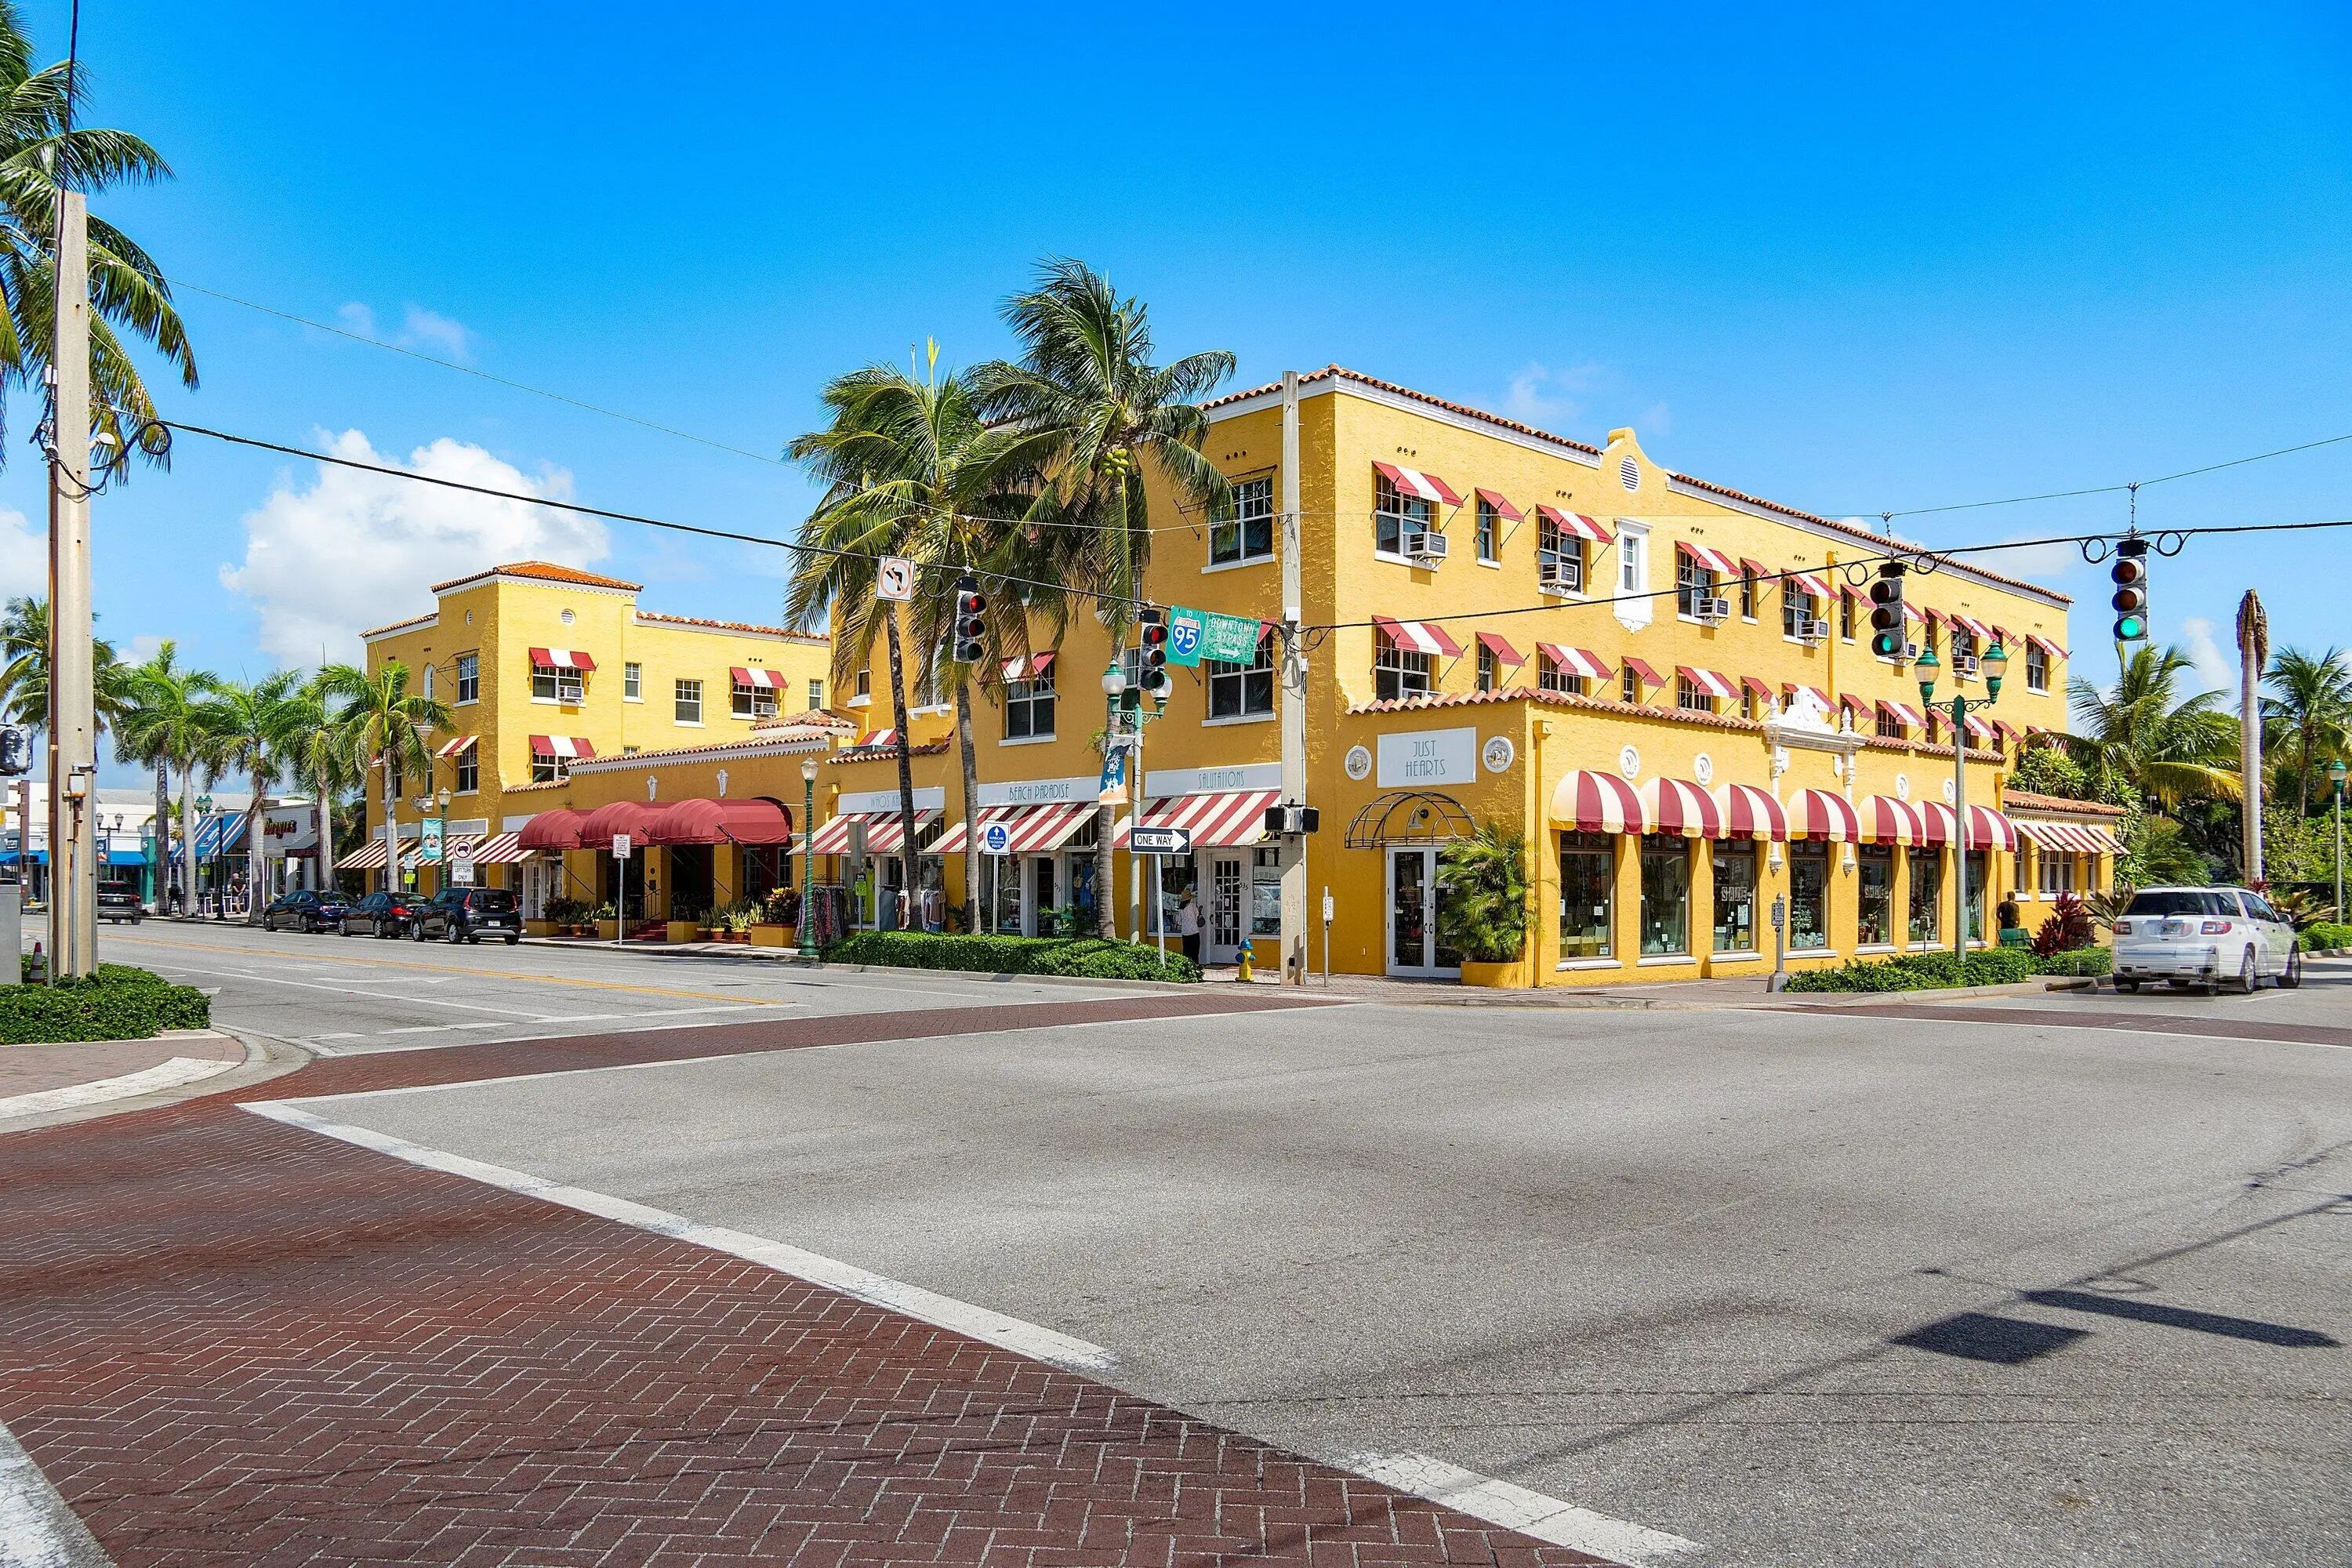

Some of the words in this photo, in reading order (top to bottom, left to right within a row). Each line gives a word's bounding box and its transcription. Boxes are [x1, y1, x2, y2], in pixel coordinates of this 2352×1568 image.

[1210, 617, 1255, 634] DOWNTOWN
[1174, 626, 1196, 649] 95
[1216, 632, 1248, 647] BYPASS
[1414, 740, 1436, 757] JUST
[1405, 759, 1446, 777] HEARTS
[1198, 771, 1245, 789] SALUTATIONS
[1009, 786, 1032, 801] BEACH
[1034, 783, 1069, 800] PARADISE
[891, 794, 901, 808] KA
[1137, 835, 1153, 845] ONE
[1156, 835, 1173, 846] WAY
[1722, 887, 1747, 901] SALE
